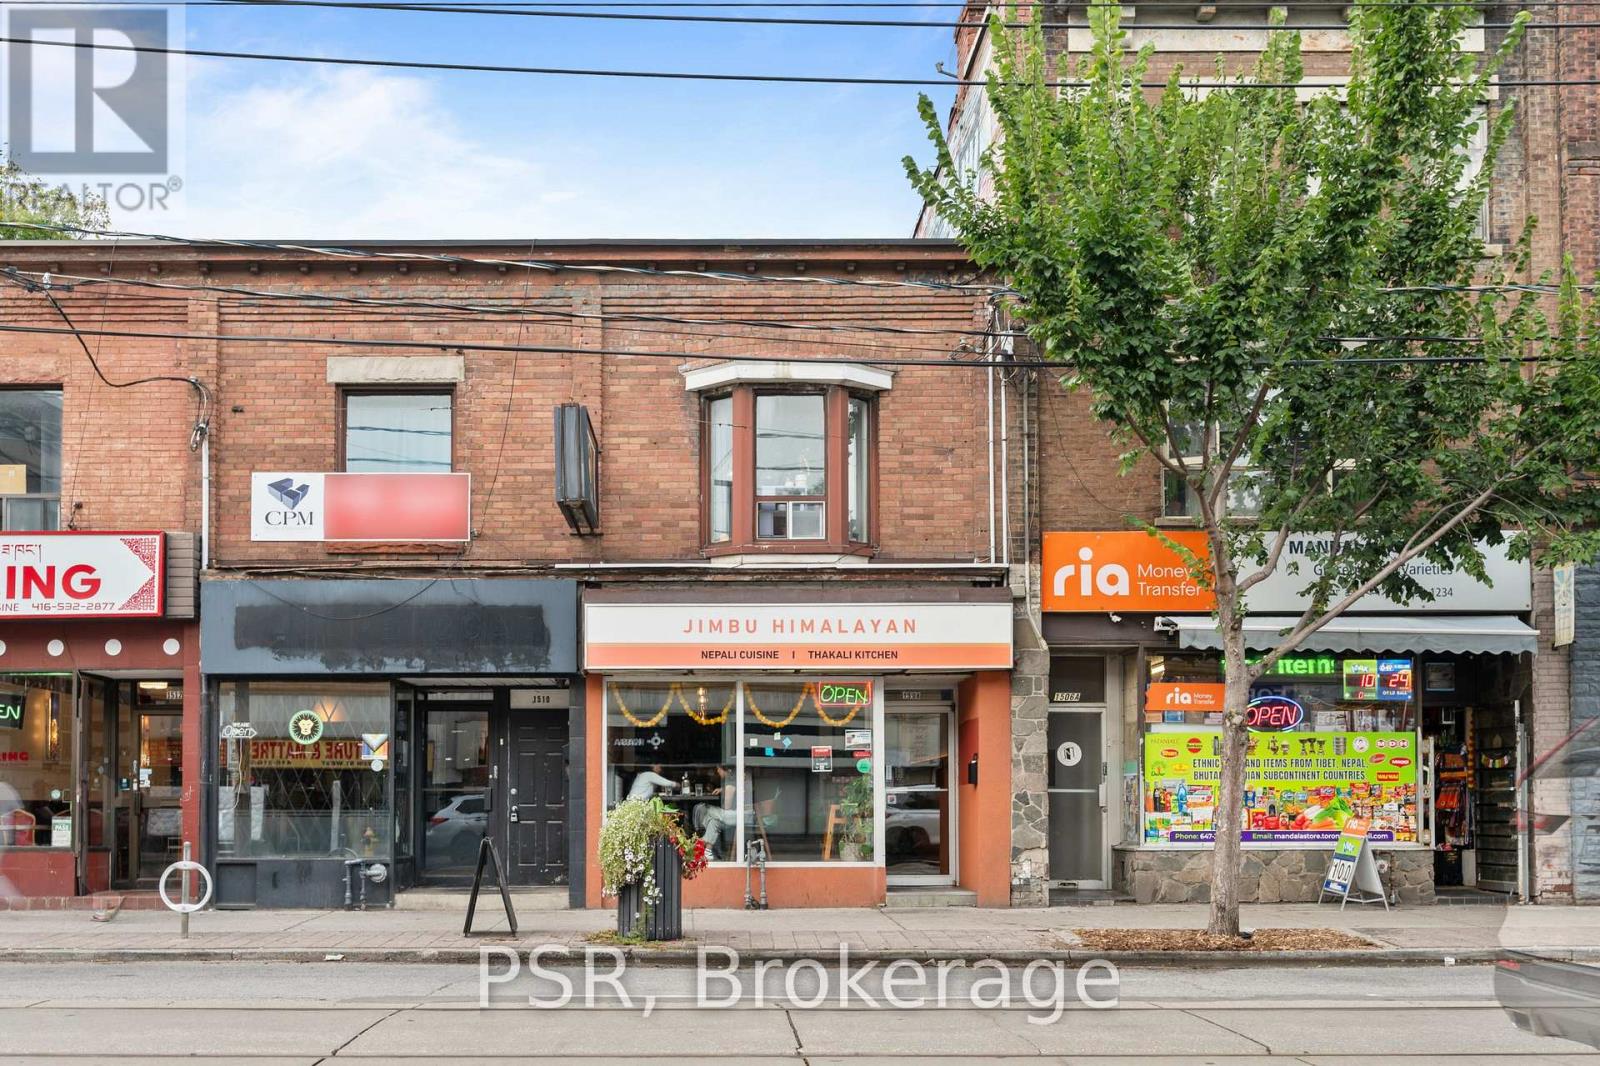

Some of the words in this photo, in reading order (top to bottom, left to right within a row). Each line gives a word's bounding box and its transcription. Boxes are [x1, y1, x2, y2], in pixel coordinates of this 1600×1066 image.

[265, 511, 313, 525] CPM
[1053, 547, 1130, 596] ria
[1137, 564, 1193, 580] Money
[1137, 582, 1201, 596] Transfer
[0, 602, 20, 611] INE
[32, 602, 115, 611] 416-532-2877
[683, 619, 757, 633] JIMBU
[772, 619, 916, 633] HIMALAYAN
[701, 650, 737, 659] NEPALI
[739, 650, 780, 659] CUISINE
[808, 650, 852, 659] THAKALI
[854, 650, 898, 659] KITCHEN
[1389, 674, 1408, 687] 24
[821, 685, 868, 704] OPEN
[1054, 693, 1081, 701] 1506A
[1166, 687, 1192, 704] ria
[1247, 706, 1298, 726] OPEN
[1193, 759, 1220, 767] ETHNIC
[1245, 759, 1261, 767] AND
[1263, 759, 1287, 767] ITEMS
[1290, 759, 1312, 767] FROM
[1263, 771, 1320, 780] SUBCONTINENT
[1252, 832, 1273, 840] Email:
